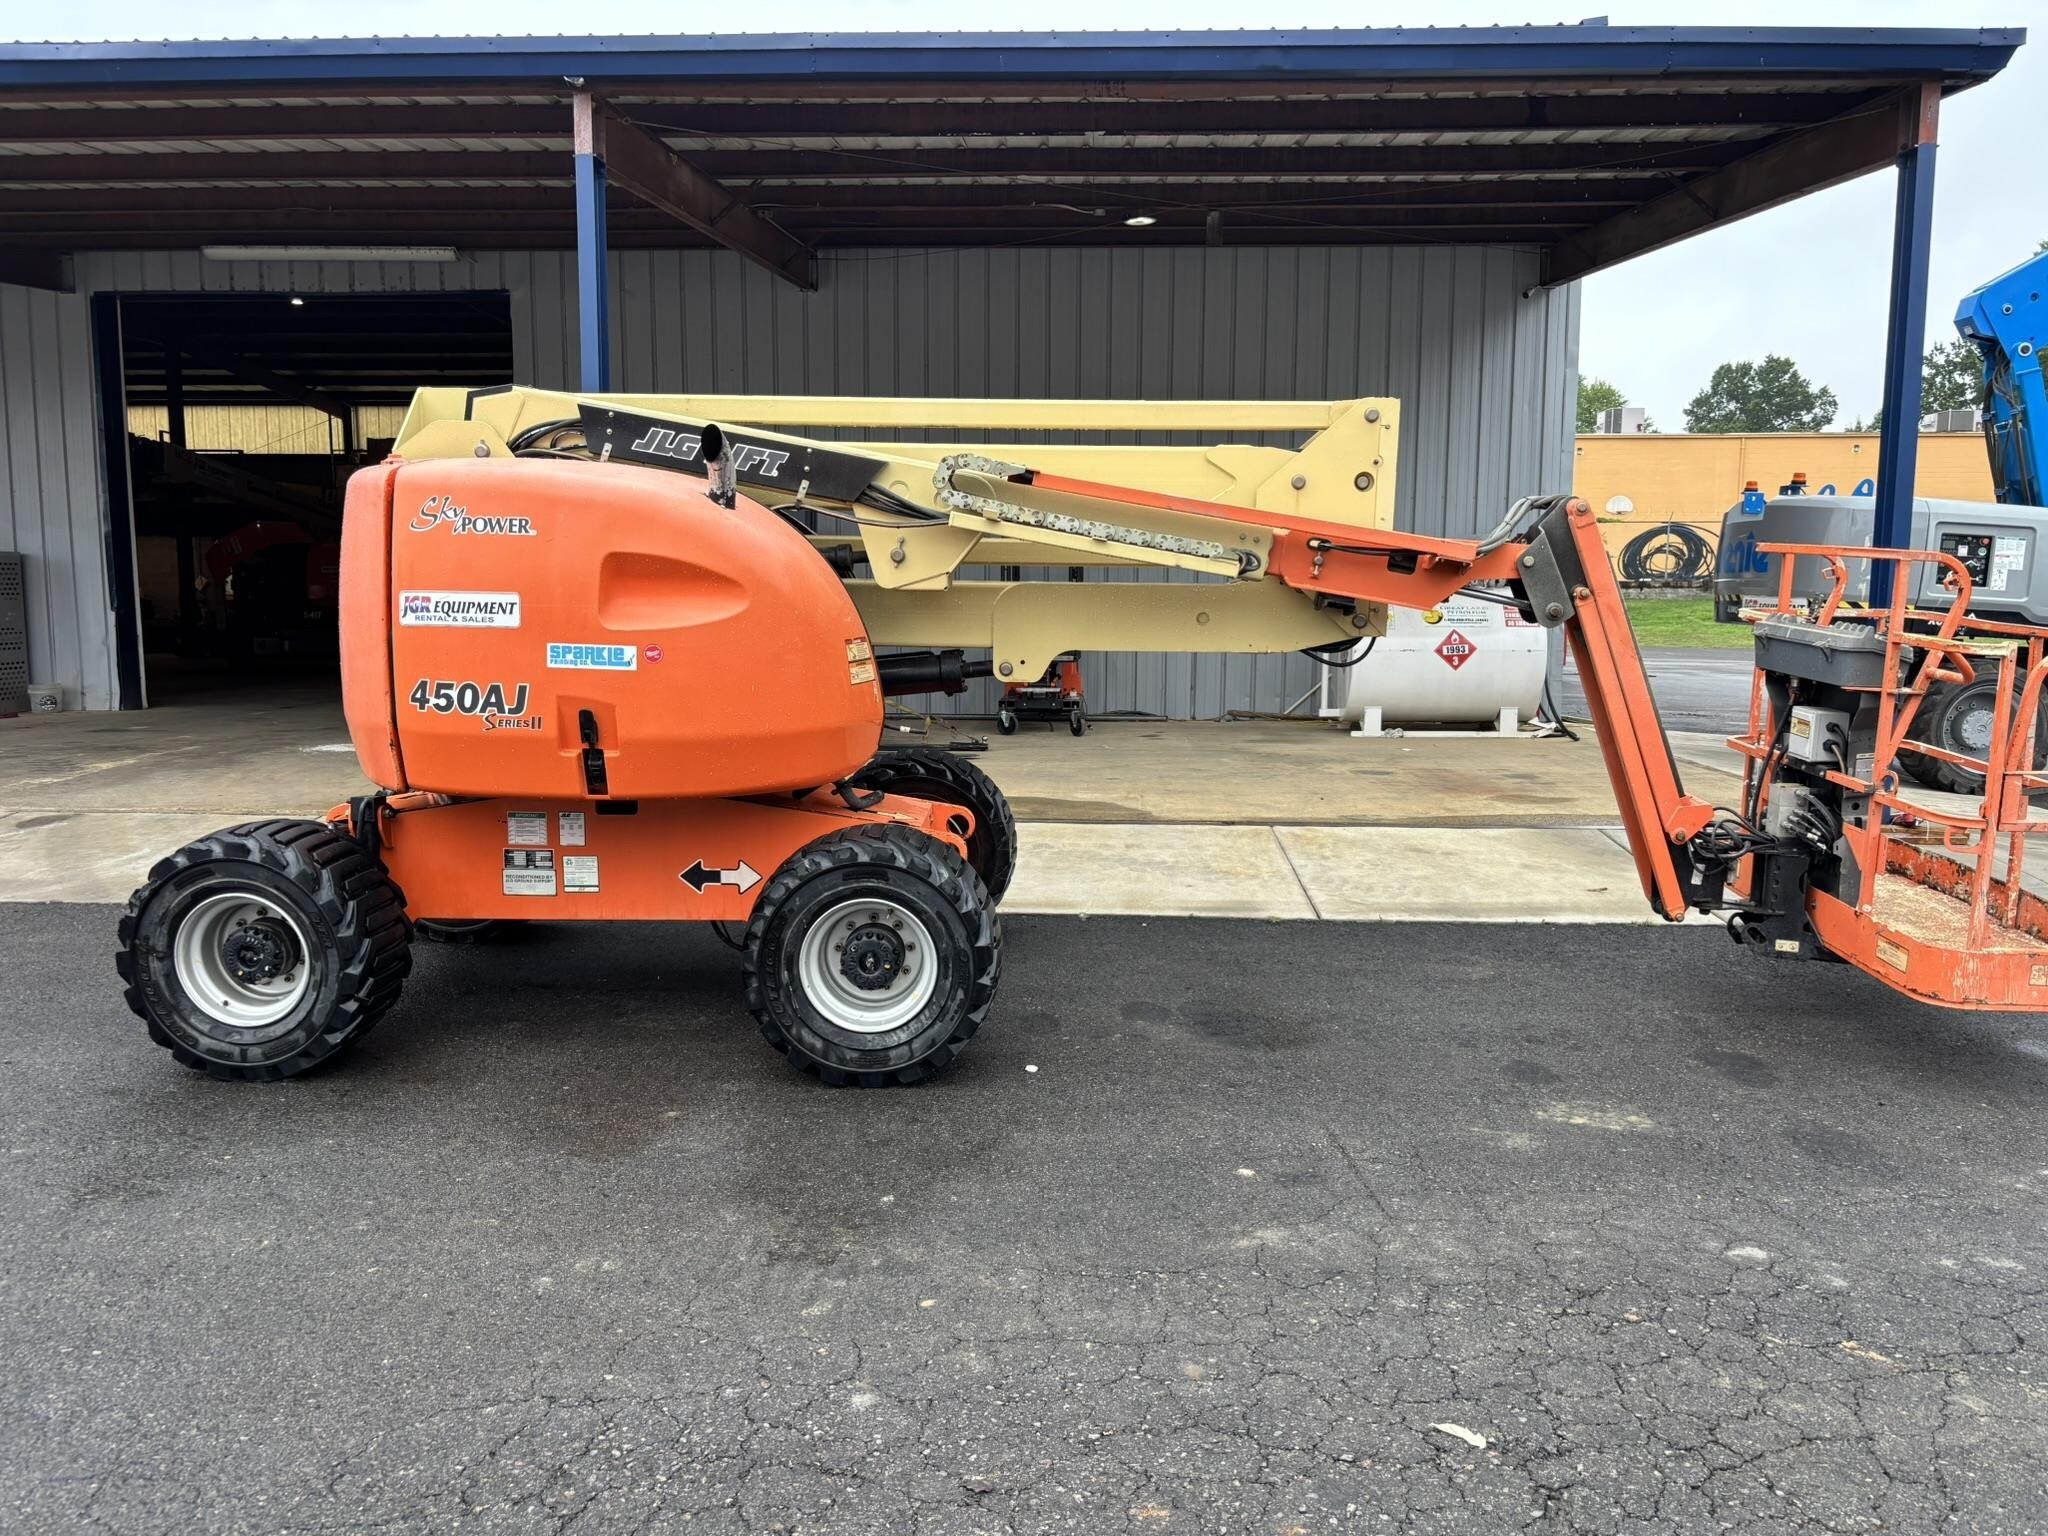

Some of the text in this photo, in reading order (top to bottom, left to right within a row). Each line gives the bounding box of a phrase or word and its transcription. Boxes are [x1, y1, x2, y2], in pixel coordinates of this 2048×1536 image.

[632, 427, 790, 477] JLG IFT
[410, 495, 532, 535] Sky POWER
[401, 595, 518, 619] JGR EQUIPMENT
[1445, 645, 1466, 654] 1993
[1452, 656, 1459, 666] 3
[409, 679, 529, 716] 450AJ
